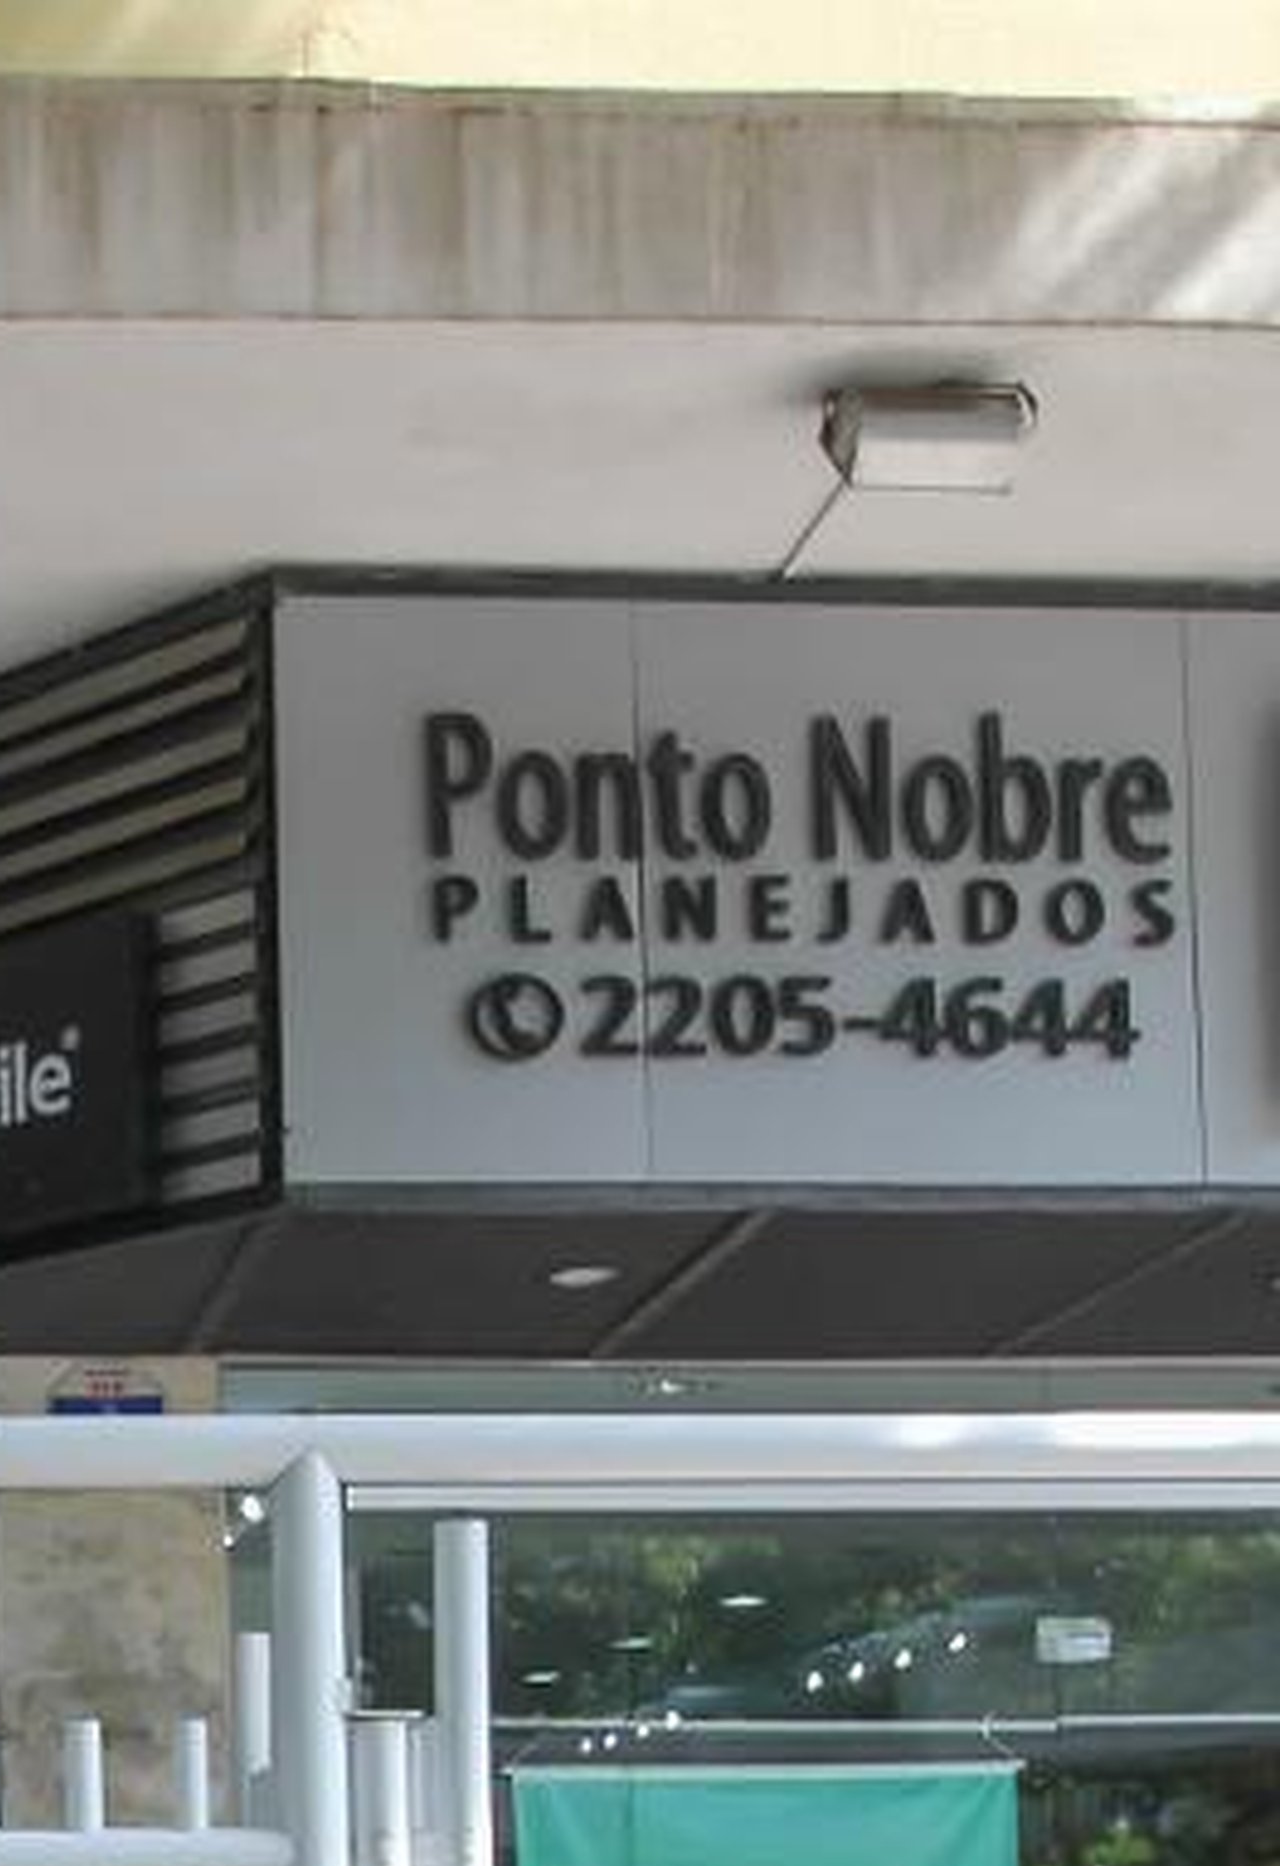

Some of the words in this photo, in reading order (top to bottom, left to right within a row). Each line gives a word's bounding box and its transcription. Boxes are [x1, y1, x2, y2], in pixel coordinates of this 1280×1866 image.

[422, 711, 773, 863] Ponto
[809, 710, 1175, 864] Nobre
[427, 874, 1177, 946] PLANEJADOS
[580, 974, 1142, 1060] 2205-4644
